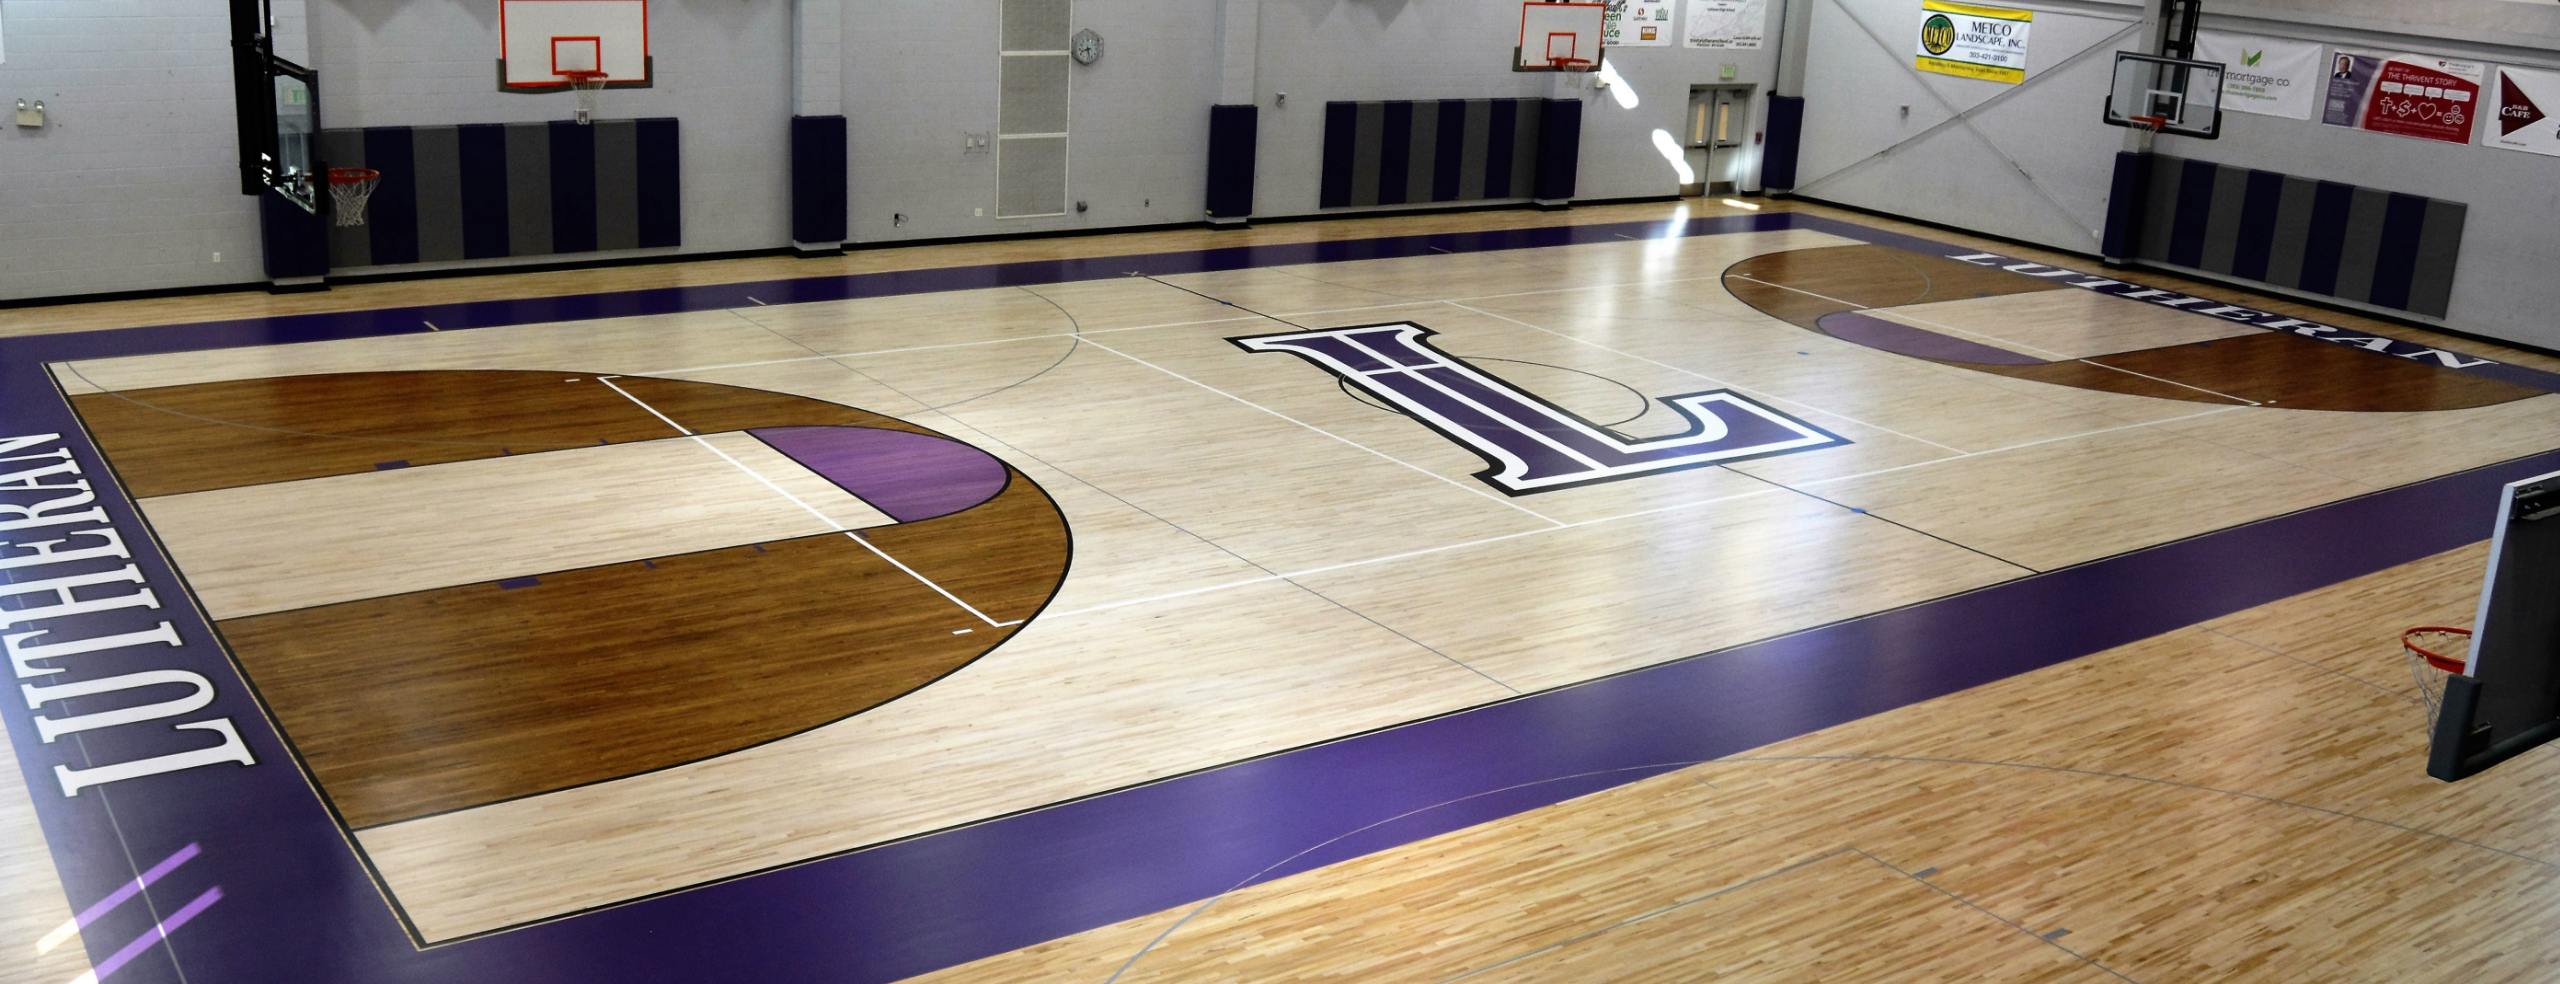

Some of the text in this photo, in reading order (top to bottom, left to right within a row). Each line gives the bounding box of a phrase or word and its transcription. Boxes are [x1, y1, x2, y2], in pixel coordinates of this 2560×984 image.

[1604, 13, 1622, 21] een
[1603, 29, 1620, 38] uce
[1927, 26, 1952, 45] METCO
[1971, 21, 2012, 37] METCO
[1956, 32, 2006, 48] LANDSCAPE,
[2008, 39, 2026, 50] INC.
[2226, 71, 2274, 87] mortgage
[2387, 72, 2458, 87] THE THRIVENT STORY
[2501, 106, 2531, 119] CAFE
[1945, 251, 2499, 369] LUTHERAN
[1223, 320, 1855, 497] L
